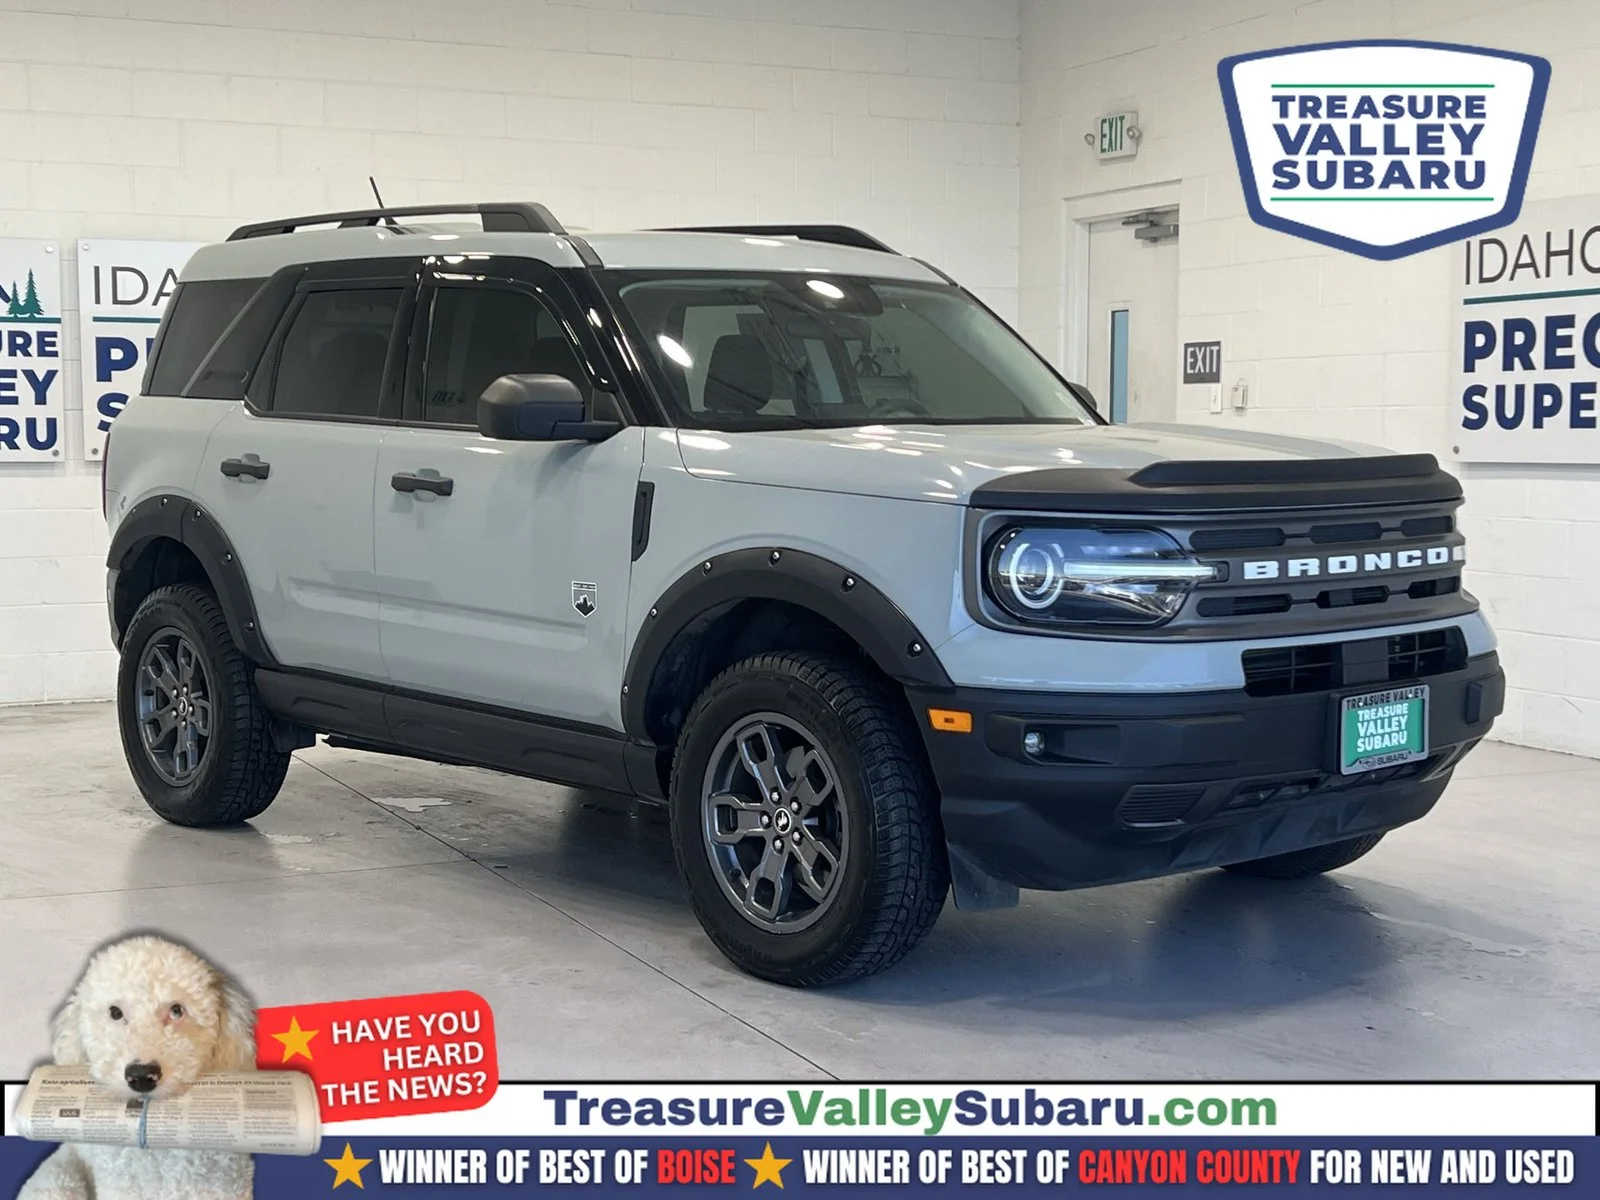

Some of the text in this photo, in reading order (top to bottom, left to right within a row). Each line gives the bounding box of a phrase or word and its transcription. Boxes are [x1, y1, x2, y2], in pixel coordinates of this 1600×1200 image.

[1100, 115, 1125, 153] EXIT
[1186, 346, 1220, 373] EXIT
[1243, 546, 1449, 580] BRONCO
[1346, 687, 1425, 709] TREASURE VALLEY
[1358, 703, 1409, 721] TREASURE
[1357, 715, 1408, 736] VALLEY
[1357, 730, 1408, 752] SUBARU
